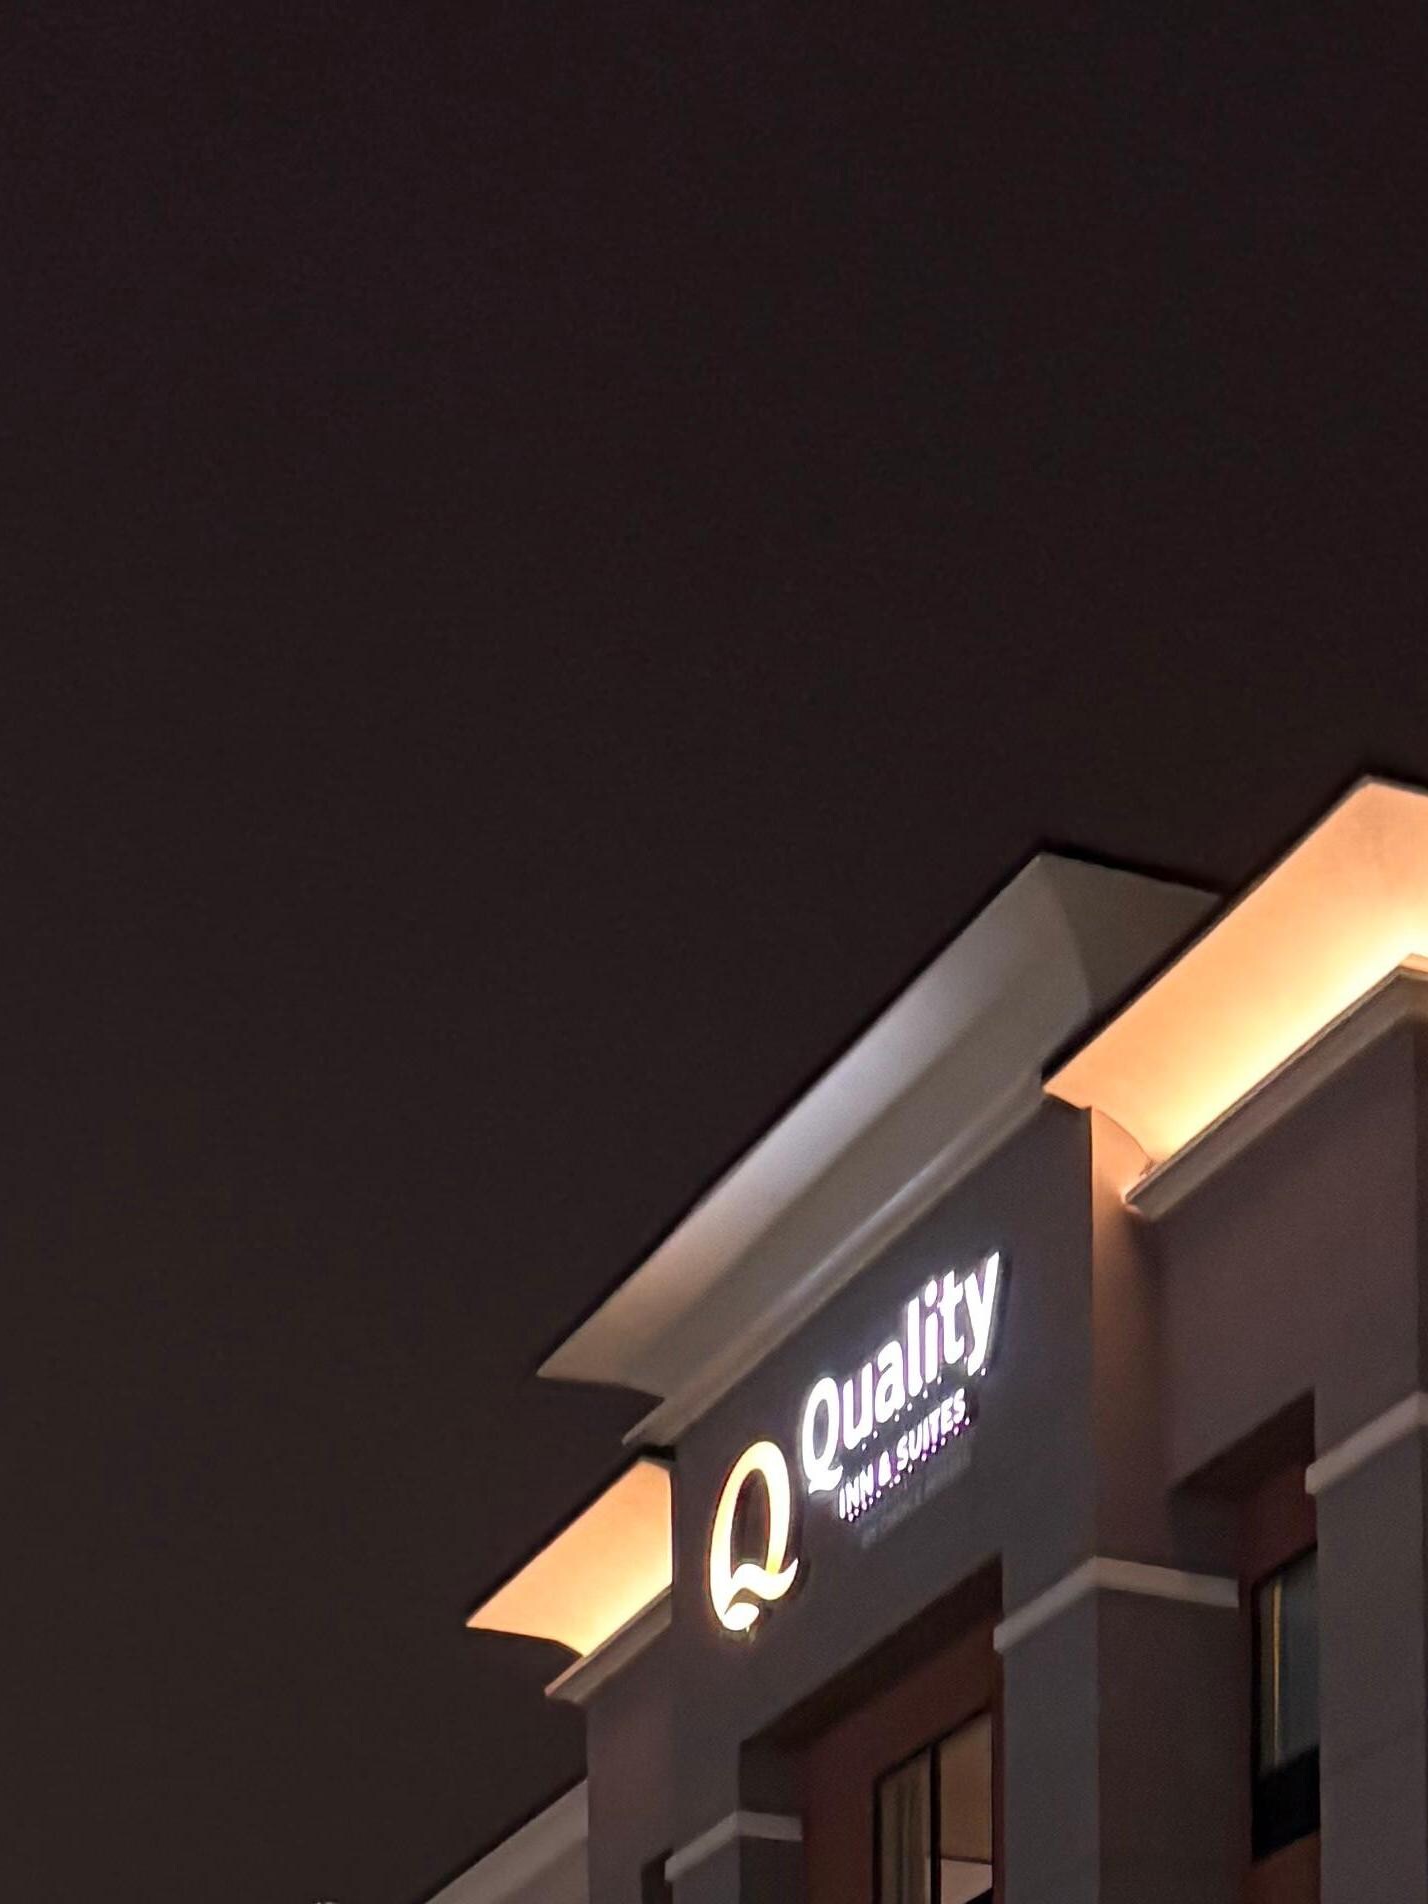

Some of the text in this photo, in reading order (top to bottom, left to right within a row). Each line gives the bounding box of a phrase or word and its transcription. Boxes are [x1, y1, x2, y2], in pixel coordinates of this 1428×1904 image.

[802, 1251, 1000, 1494] Quality
[838, 1387, 966, 1520] INN & SUITES
[709, 1440, 799, 1631] Q
